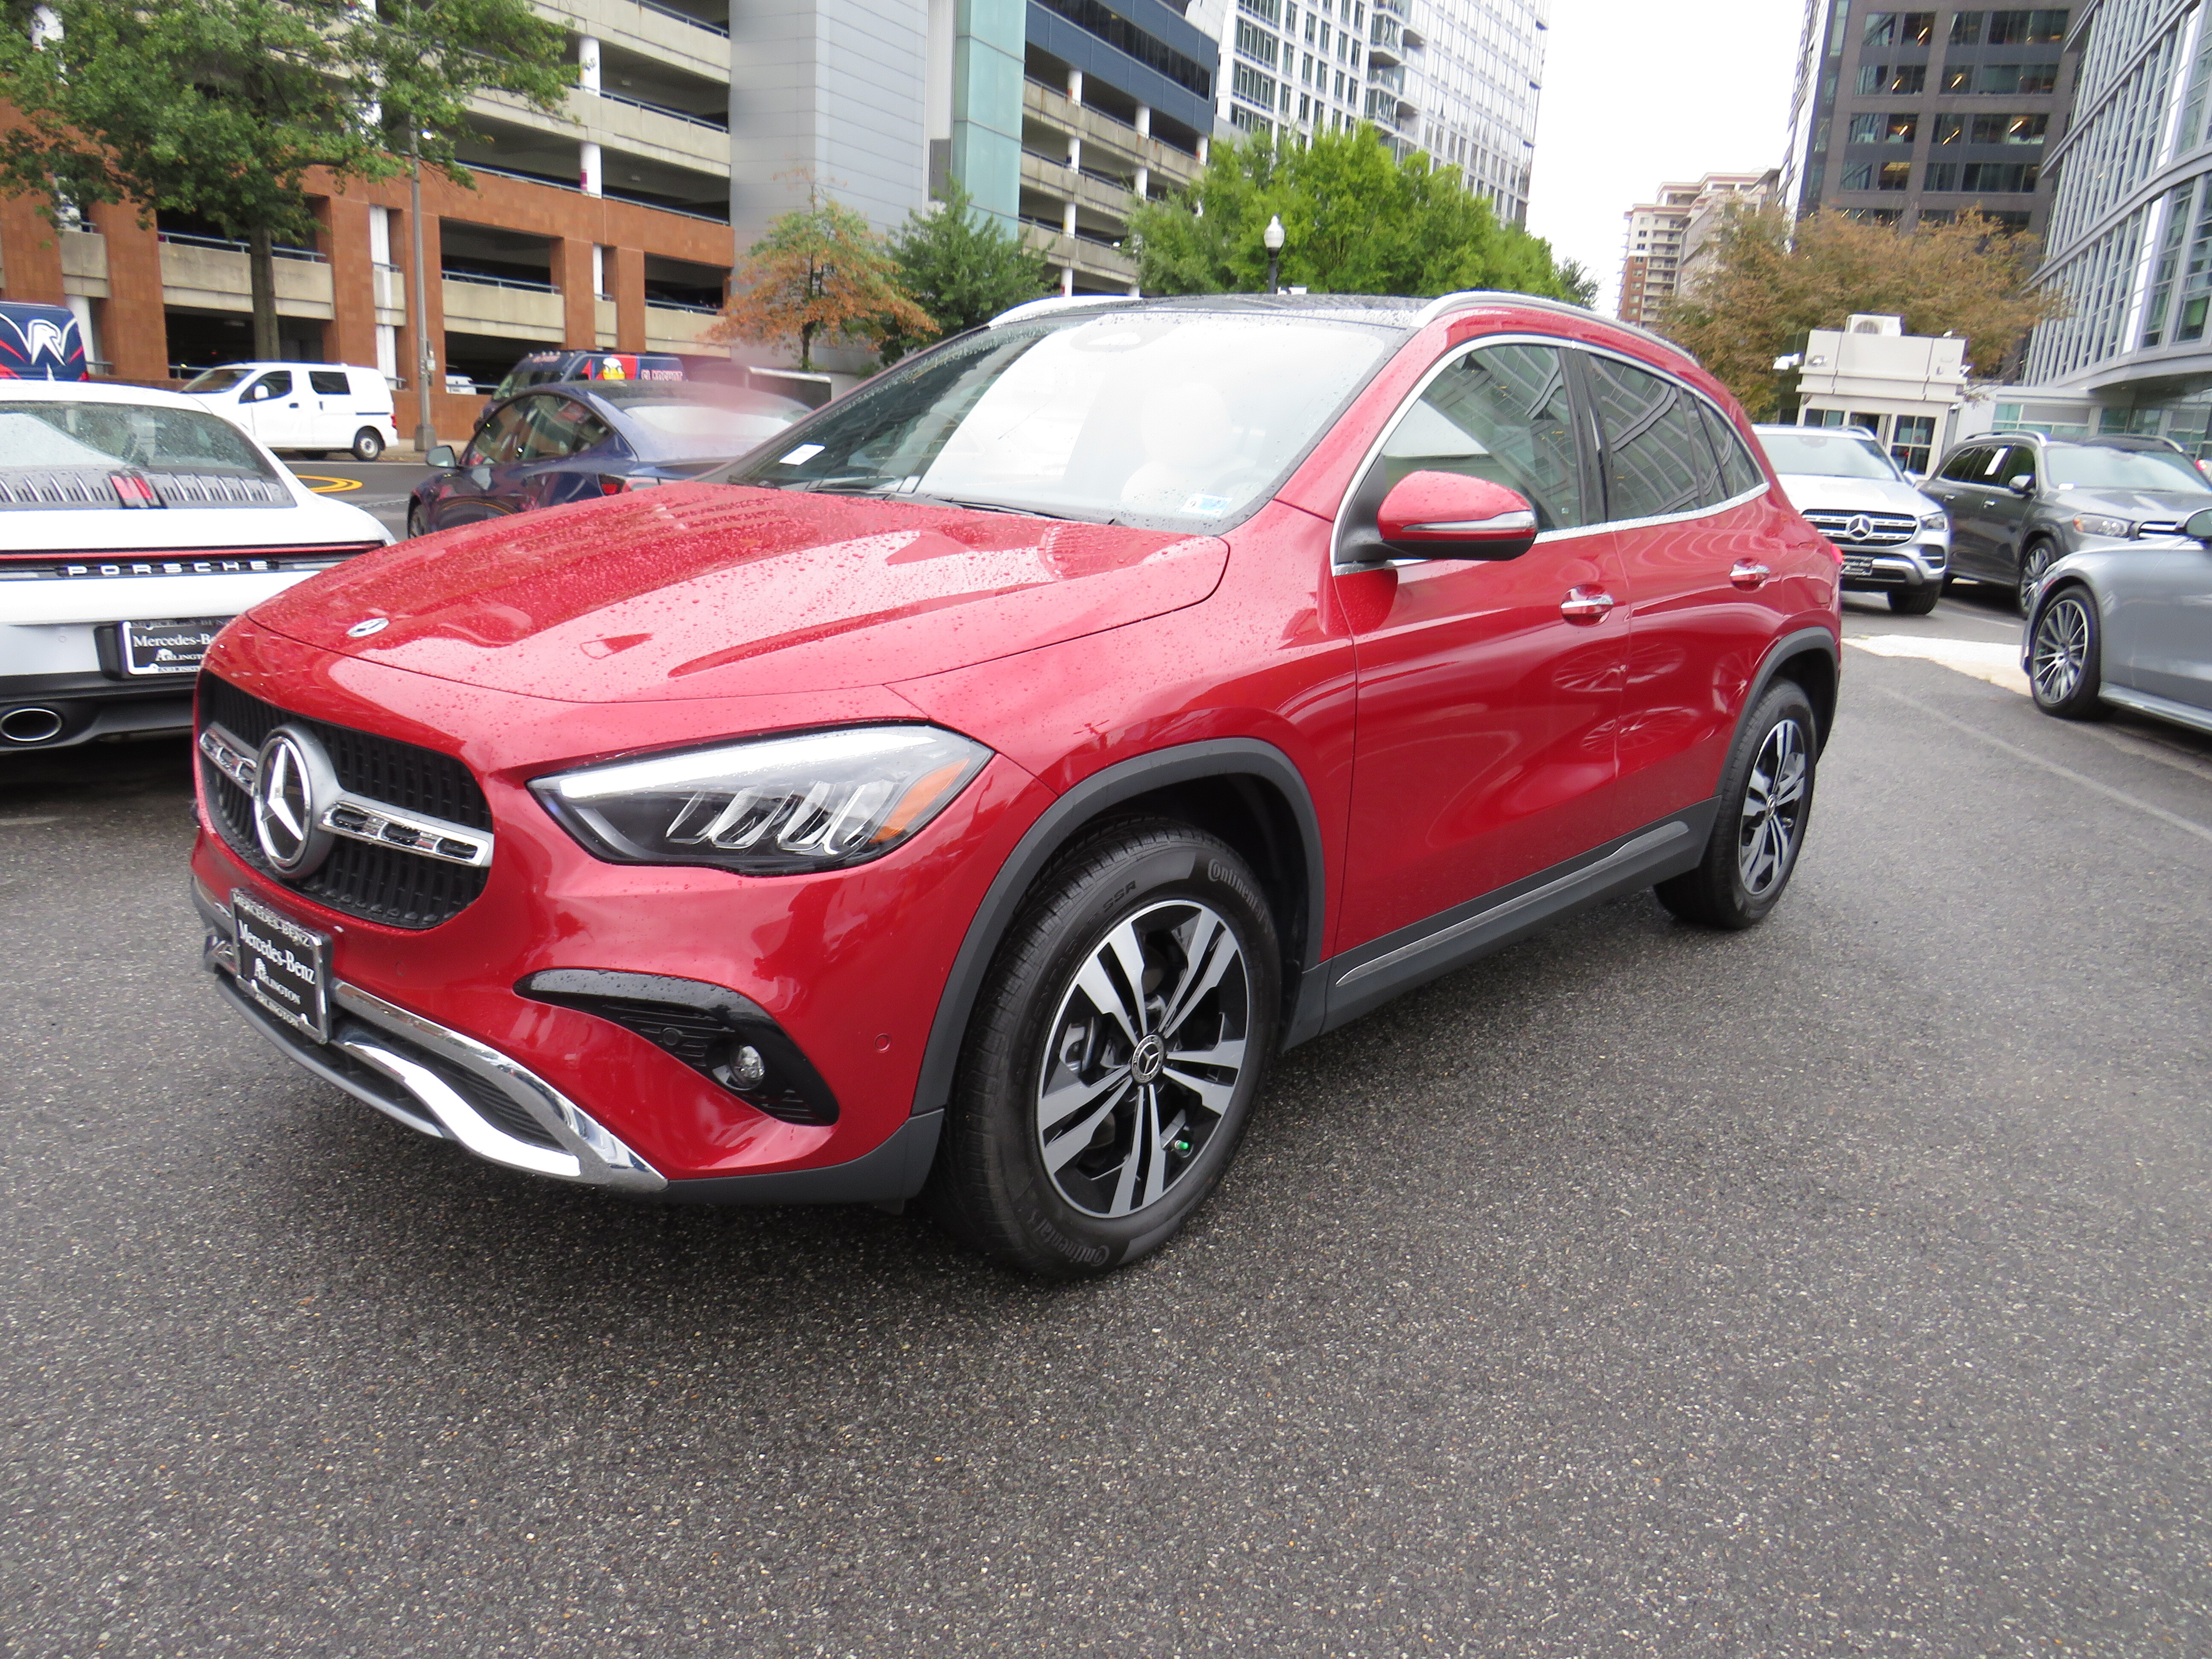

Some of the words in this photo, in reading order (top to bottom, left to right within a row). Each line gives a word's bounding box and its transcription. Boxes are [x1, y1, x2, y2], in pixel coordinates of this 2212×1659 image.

[67, 560, 268, 576] PORSCHE
[1102, 880, 1137, 912] SSR
[238, 919, 315, 985] Mercedes-Benz
[1033, 1218, 1110, 1267] Continental
